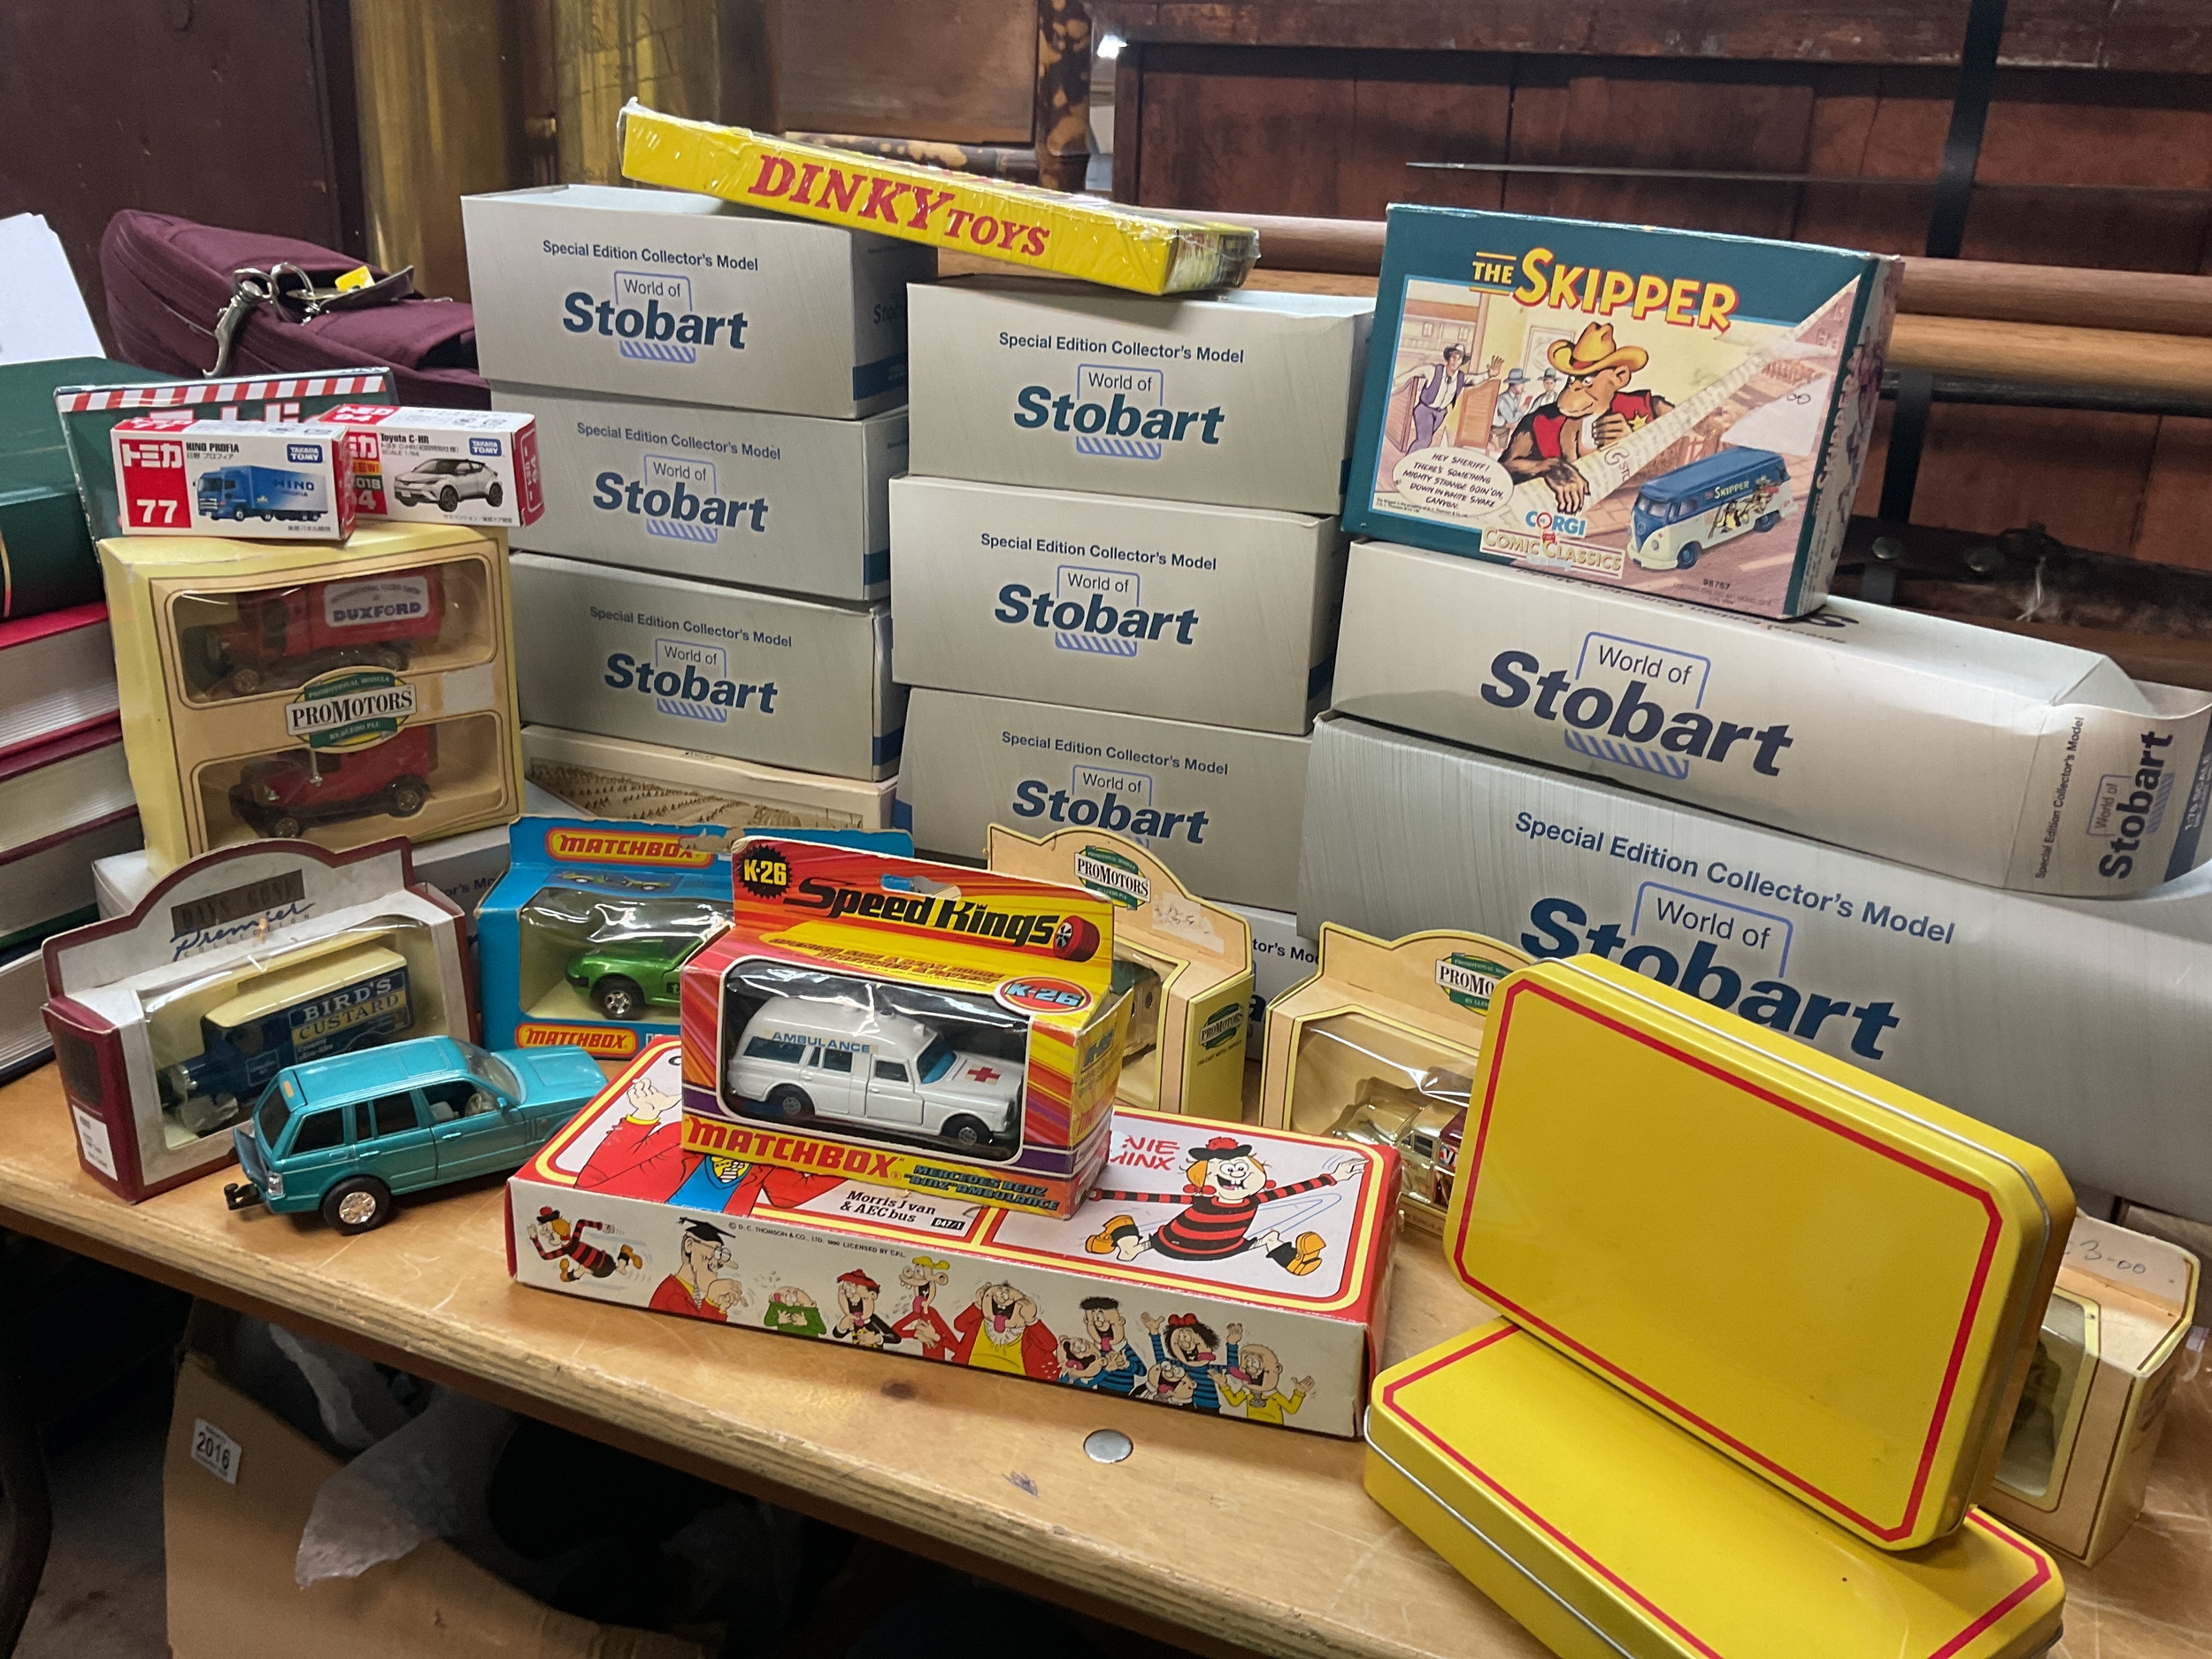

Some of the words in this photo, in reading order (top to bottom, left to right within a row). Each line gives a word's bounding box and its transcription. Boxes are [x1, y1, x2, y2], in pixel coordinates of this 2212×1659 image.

[748, 154, 955, 230] DINKY
[945, 210, 1050, 257] TOYS
[542, 240, 589, 257] Special
[593, 244, 638, 261] Edition
[641, 249, 712, 267] Collector's
[717, 255, 758, 271] Model
[624, 279, 664, 296] World
[668, 284, 681, 297] of
[1471, 260, 1515, 285] THE
[1512, 247, 1740, 332] SKIPPER
[563, 291, 748, 349] Stobart
[999, 332, 1052, 349] Special
[1056, 336, 1107, 354] Edition
[1111, 341, 1192, 360] Collector's
[1196, 347, 1244, 364] Model
[1088, 373, 1133, 390] World
[1138, 377, 1152, 392] of
[1014, 386, 1225, 445] Stobart
[186, 442, 207, 452] HINO
[210, 442, 240, 453] PROFIA
[380, 433, 407, 443] Toyota
[409, 434, 430, 444] C-HR
[472, 446, 498, 456] TOMY
[577, 422, 621, 439] Special
[625, 428, 668, 445] Edition
[671, 434, 739, 454] Collector's
[741, 444, 781, 460] Model
[121, 443, 183, 469] トミカ
[653, 461, 690, 480] World
[695, 468, 706, 481] of
[1432, 453, 1449, 463] HEY
[275, 480, 315, 491] HINO
[1403, 470, 1432, 482] MIGHTY
[1433, 477, 1468, 490] STRANGE
[1414, 462, 1444, 474] THERE'S
[1447, 469, 1492, 484] SOMETHING
[593, 472, 768, 533] Stobart
[1409, 483, 1434, 494] DOWN
[1444, 490, 1468, 502] WHITE
[1471, 496, 1495, 508] SNAKE
[1425, 496, 1458, 510] CANYON.
[1715, 480, 1749, 499] SKIPPER
[136, 499, 178, 524] 77
[1525, 511, 1586, 536] CORGI
[981, 533, 1032, 550] Special
[1036, 539, 1086, 557] Edition
[1090, 545, 1167, 565] Collector's
[1171, 554, 1217, 571] Model
[1482, 526, 1540, 555] COMIC
[1542, 541, 1621, 572] CLASSICS
[1068, 572, 1110, 591] World
[1115, 580, 1130, 594] of
[333, 602, 421, 621] DUXFORD
[590, 606, 634, 623] Special
[637, 613, 680, 630] Edition
[683, 620, 749, 641] Collector's
[753, 631, 792, 647] Model
[995, 584, 1199, 645] Stobart
[664, 645, 701, 663] World
[705, 653, 717, 664] of
[1599, 644, 1663, 678] World
[1668, 664, 1693, 685] of
[604, 653, 778, 714] Stobart
[1480, 650, 1793, 777] Stobart
[1002, 731, 1050, 749] Special
[1055, 739, 1102, 757] Edition
[1106, 747, 1180, 768] Collector's
[1184, 758, 1228, 775] Model
[1082, 772, 1124, 791] World
[1128, 780, 1142, 794] of
[2036, 844, 2051, 879] Special
[2045, 811, 2061, 843] Edition
[2054, 754, 2075, 808] Collector's
[2067, 716, 2085, 752] Model
[1012, 780, 1210, 844] Stobart
[2094, 795, 2116, 829] World
[2107, 782, 2118, 794] of
[2099, 731, 2173, 879] Stobart
[1515, 811, 1604, 852] Special
[1609, 836, 1699, 878] Edition
[1707, 863, 1854, 918] Collector's
[1861, 902, 1955, 945] Model
[783, 876, 935, 926] Speed
[934, 901, 1063, 947] Kings
[1656, 897, 1734, 941] World
[1742, 926, 1771, 950] of
[1440, 965, 1494, 995] PROMO
[1520, 897, 1901, 1061] Stobart
[303, 979, 392, 1021] BIRD'S
[1006, 983, 1083, 1008] K-26
[299, 994, 398, 1041] CUSTARD
[527, 1027, 629, 1049] MATCHBOX
[772, 1031, 871, 1054] AMBULANCE
[914, 1164, 1002, 1187] MERCEDES
[1001, 1179, 1048, 1196] BENZ
[846, 1190, 897, 1208] Morris
[898, 1200, 908, 1209] J
[908, 1203, 936, 1216] van
[956, 1183, 1060, 1210] AMBULANCE
[840, 1201, 852, 1211] &
[854, 1203, 890, 1217] AEC
[888, 1209, 917, 1223] bus
[934, 1217, 963, 1230] D47/1
[755, 1226, 787, 1237] THOMSON
[842, 1242, 878, 1254] LICENSED
[197, 1432, 230, 1470] 2016
